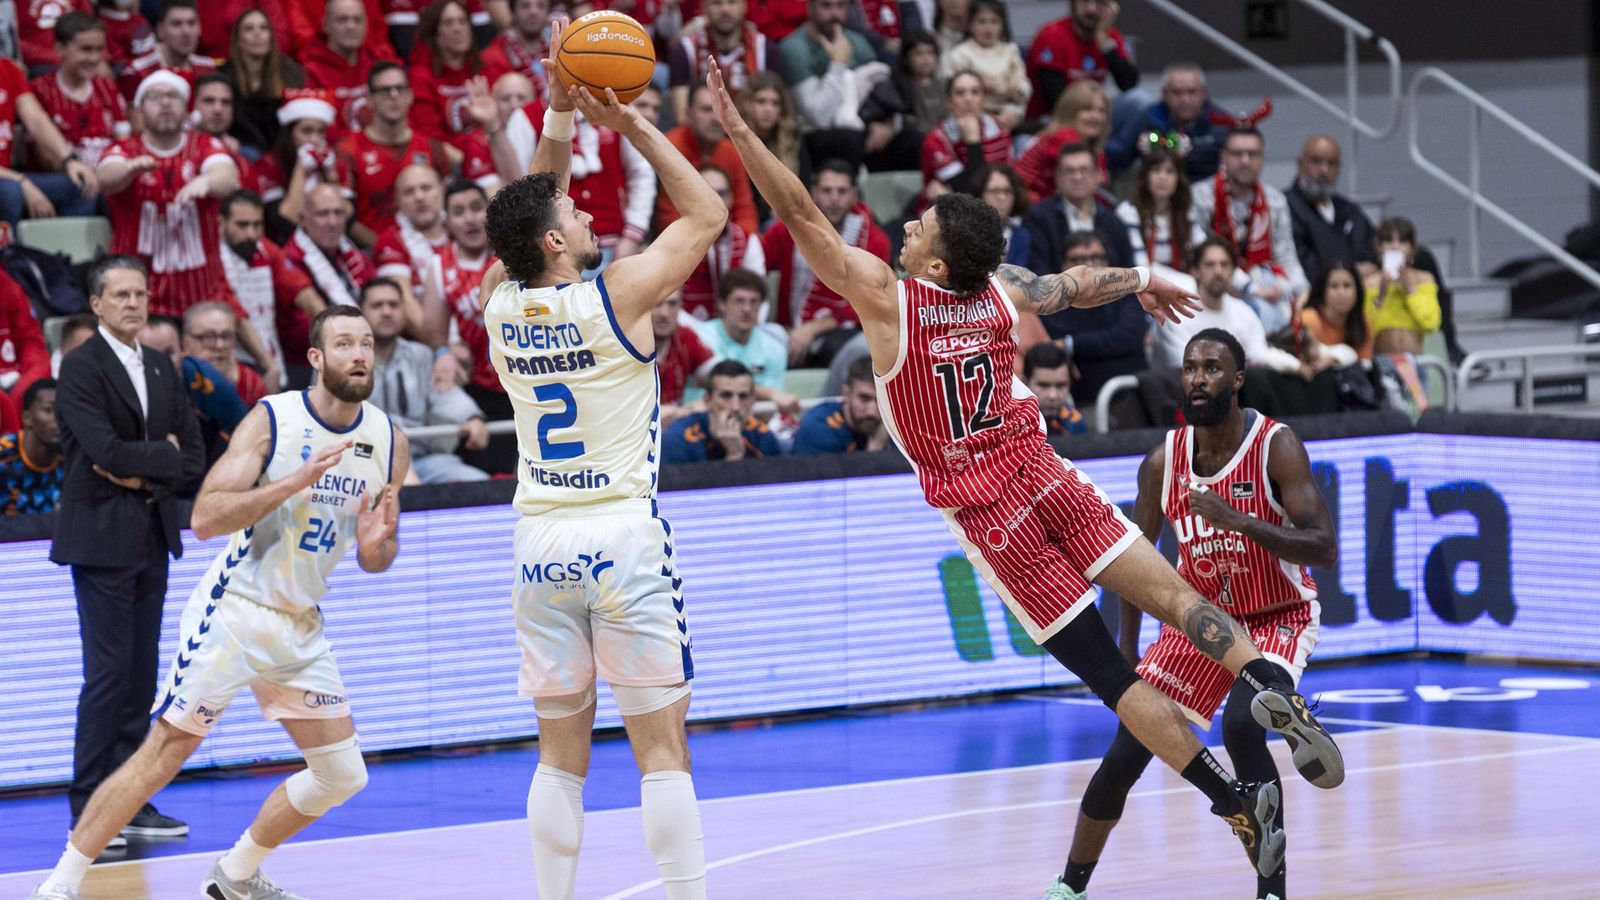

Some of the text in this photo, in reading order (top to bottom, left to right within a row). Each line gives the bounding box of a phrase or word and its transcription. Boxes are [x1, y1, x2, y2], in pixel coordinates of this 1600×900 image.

[918, 299, 996, 327] RADEBAUGH
[502, 322, 584, 349] PUERTO
[504, 350, 596, 375] PAMESA
[934, 352, 1004, 442] 12
[533, 382, 586, 461] 2
[311, 493, 346, 508] BASKET
[298, 517, 336, 554] 24
[522, 562, 583, 584] MGS
[1148, 664, 1196, 696] INVERSUS
